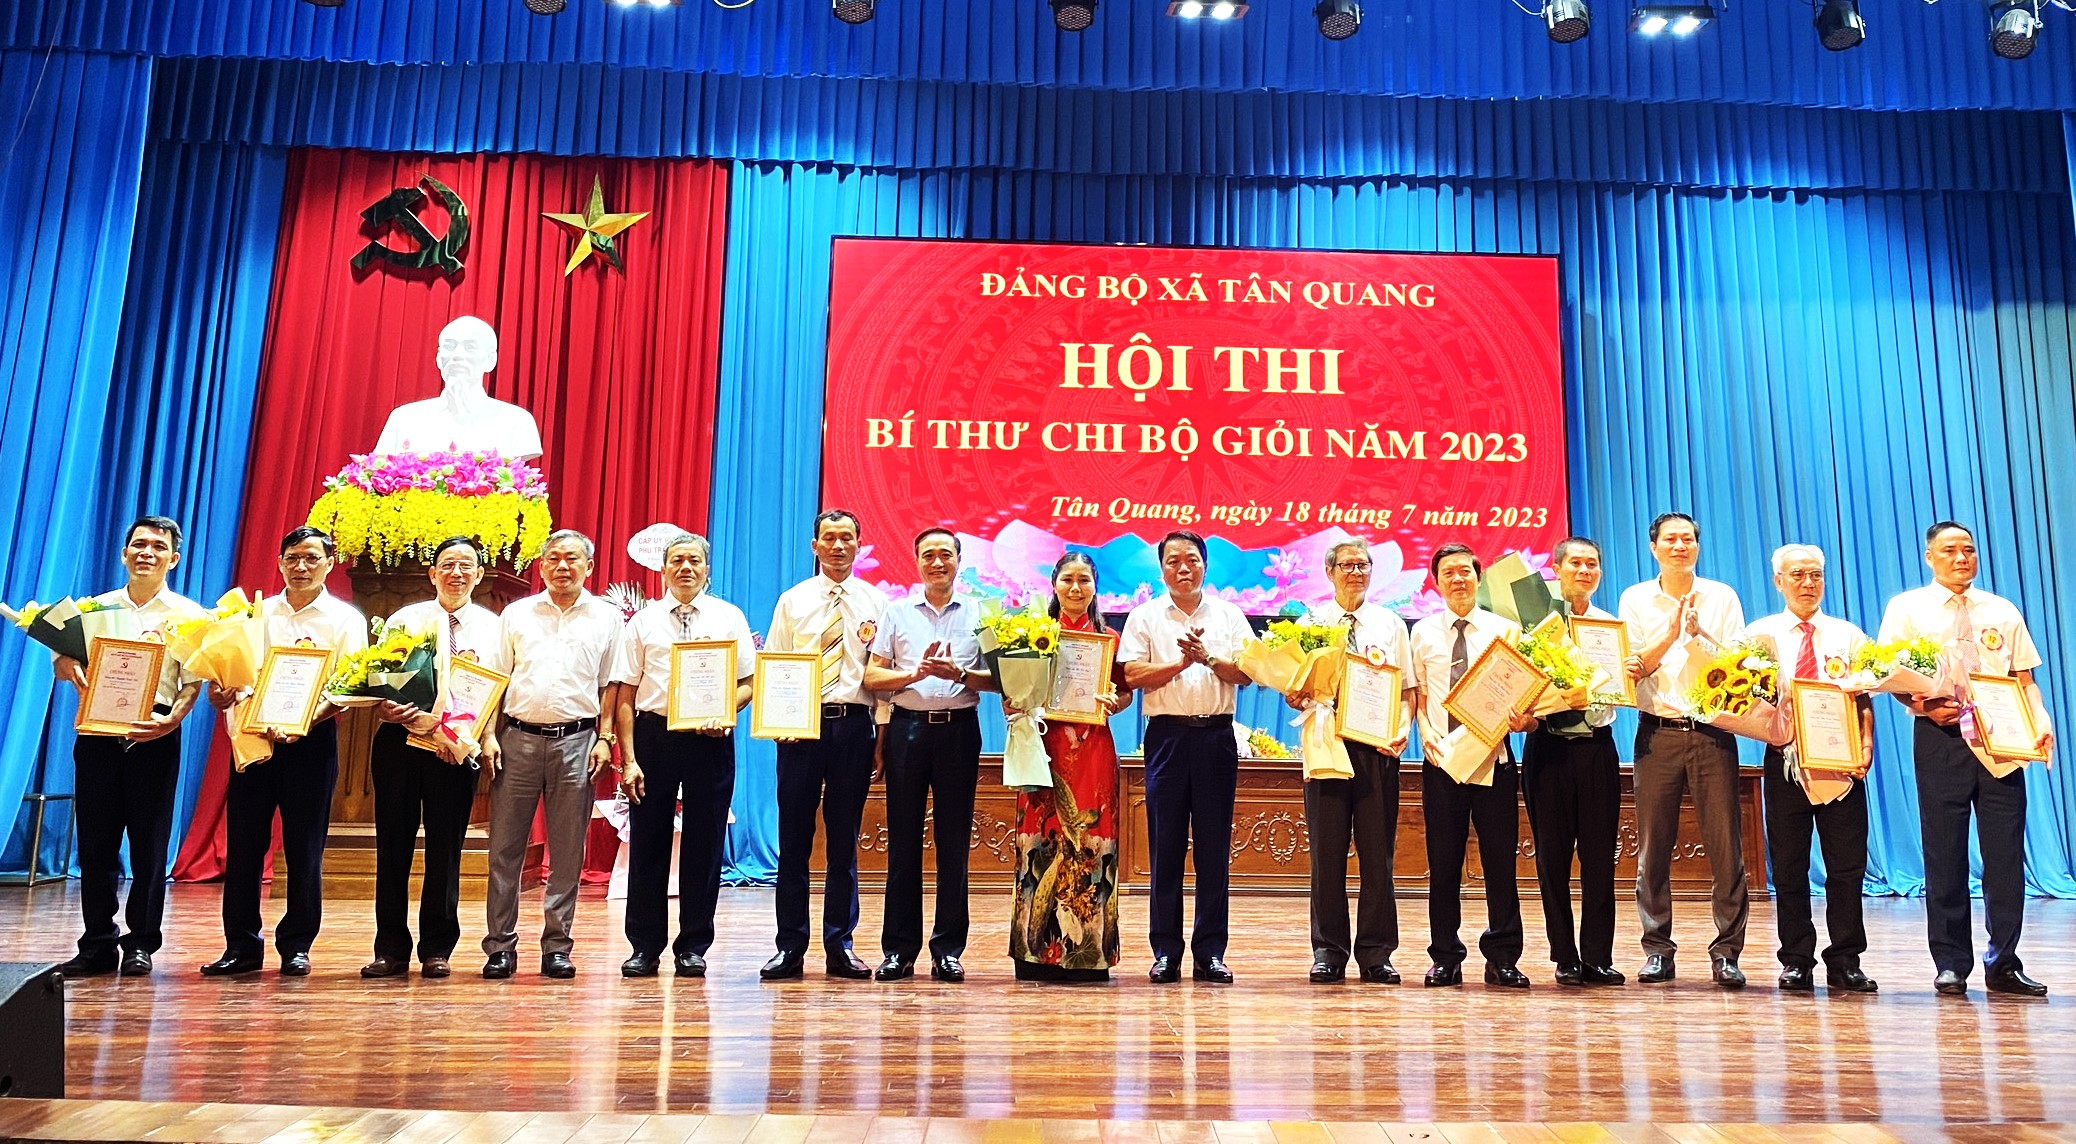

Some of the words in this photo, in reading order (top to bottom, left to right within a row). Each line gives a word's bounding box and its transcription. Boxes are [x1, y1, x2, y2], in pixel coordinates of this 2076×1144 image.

[980, 267, 1087, 298] ĐẢNG
[1097, 273, 1148, 306] BỘ
[1157, 272, 1209, 302] XÃ
[1218, 272, 1293, 303] TÂN
[1302, 281, 1436, 309] QUANG
[1058, 332, 1194, 403] HỘI
[1213, 346, 1345, 395] THI
[864, 409, 916, 448] BÍ
[927, 419, 1030, 451] THƯ
[1041, 421, 1127, 453] CHI
[1138, 417, 1199, 462] BỘ
[1212, 419, 1313, 457] GIỎI
[1324, 421, 1428, 460] NĂM
[1439, 431, 1528, 463] 2023
[1051, 496, 1100, 518] Tân
[1108, 497, 1202, 525] Quang,
[1210, 499, 1273, 527] ngày
[1279, 501, 1311, 523] 18
[1317, 502, 1393, 530] tháng
[1402, 503, 1417, 524] 7
[1422, 505, 1479, 527] năm
[1486, 506, 1548, 528] 2023
[1989, 635, 1997, 644] 12
